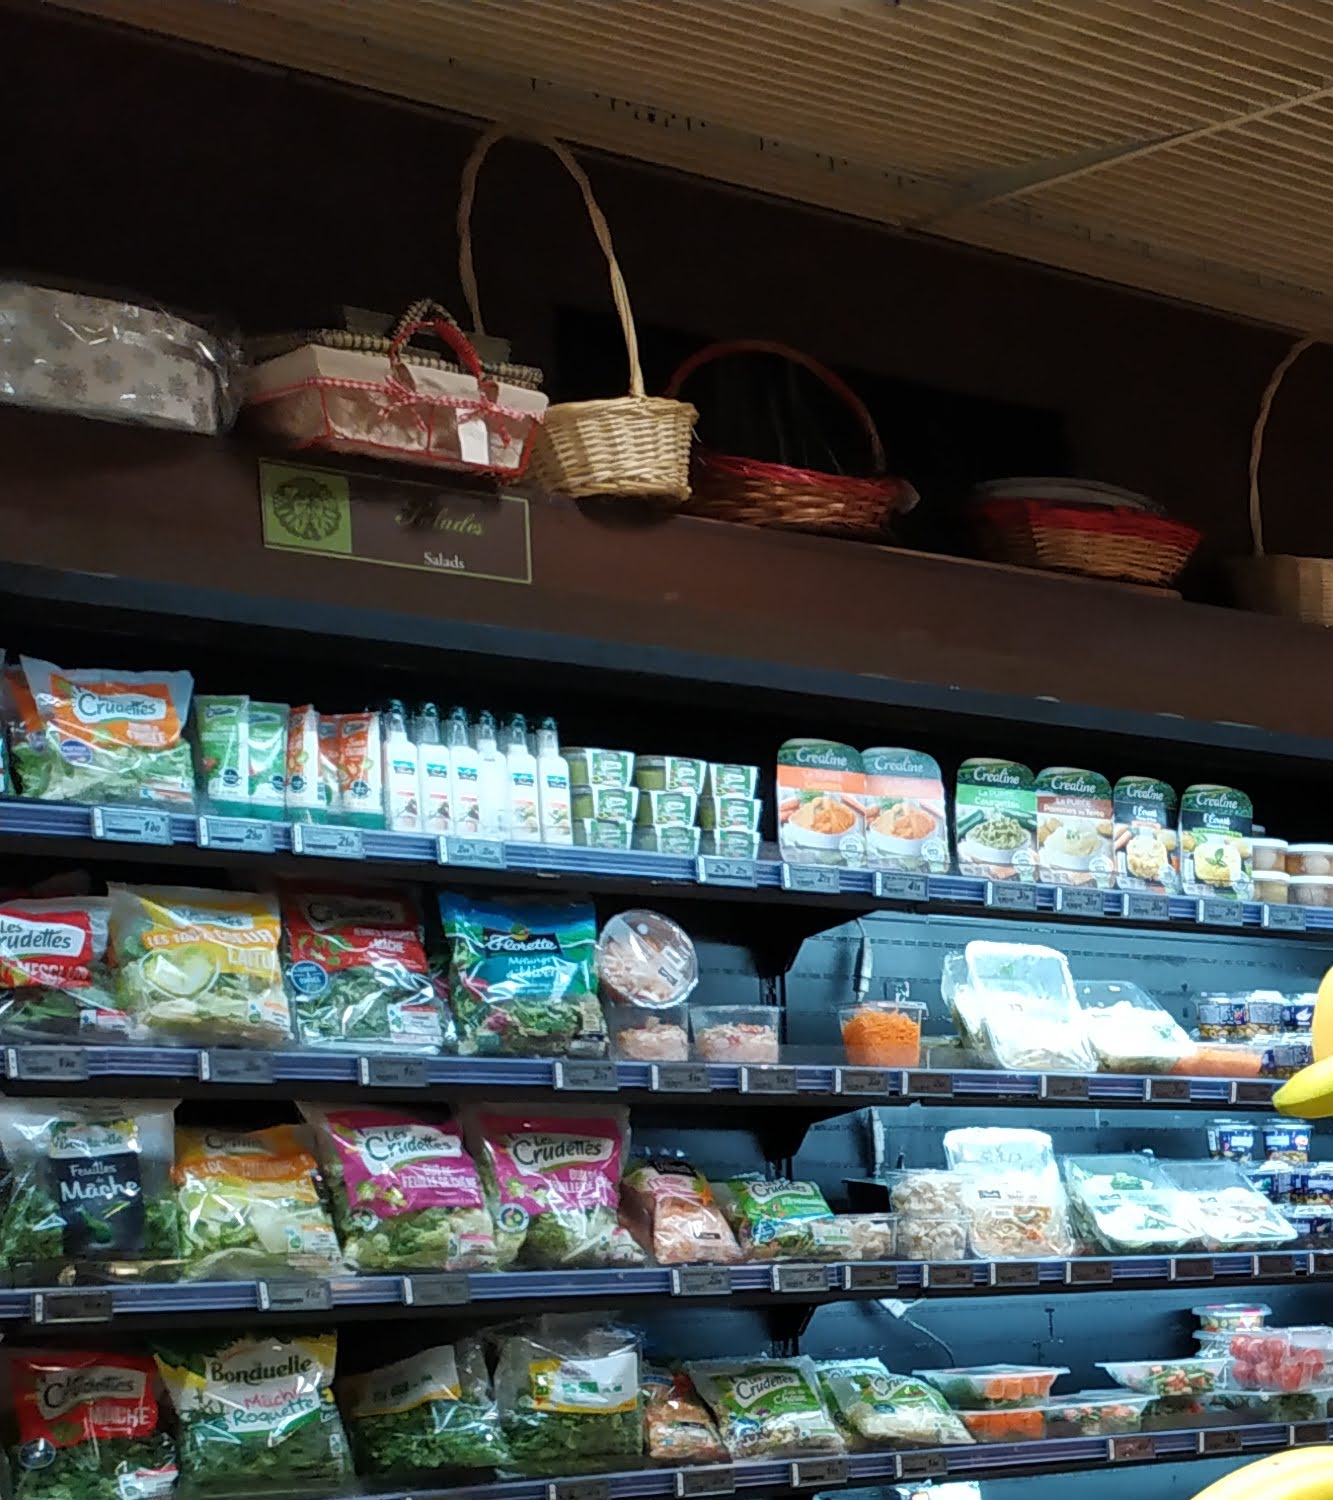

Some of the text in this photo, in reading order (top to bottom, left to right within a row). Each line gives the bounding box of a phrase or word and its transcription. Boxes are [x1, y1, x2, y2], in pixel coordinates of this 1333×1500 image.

[424, 552, 465, 570] Salads
[1, 920, 23, 934] Les
[0, 929, 71, 950] rudettes
[488, 934, 558, 951] Florette
[365, 1135, 452, 1161] Crudettes
[513, 1138, 601, 1164] Crudettes
[69, 1164, 117, 1177] Feuilles
[60, 1178, 140, 1201] Mâche
[210, 1354, 312, 1385] Bonduelle
[735, 1373, 794, 1399] Crudettes
[233, 1398, 314, 1424] Roquette
